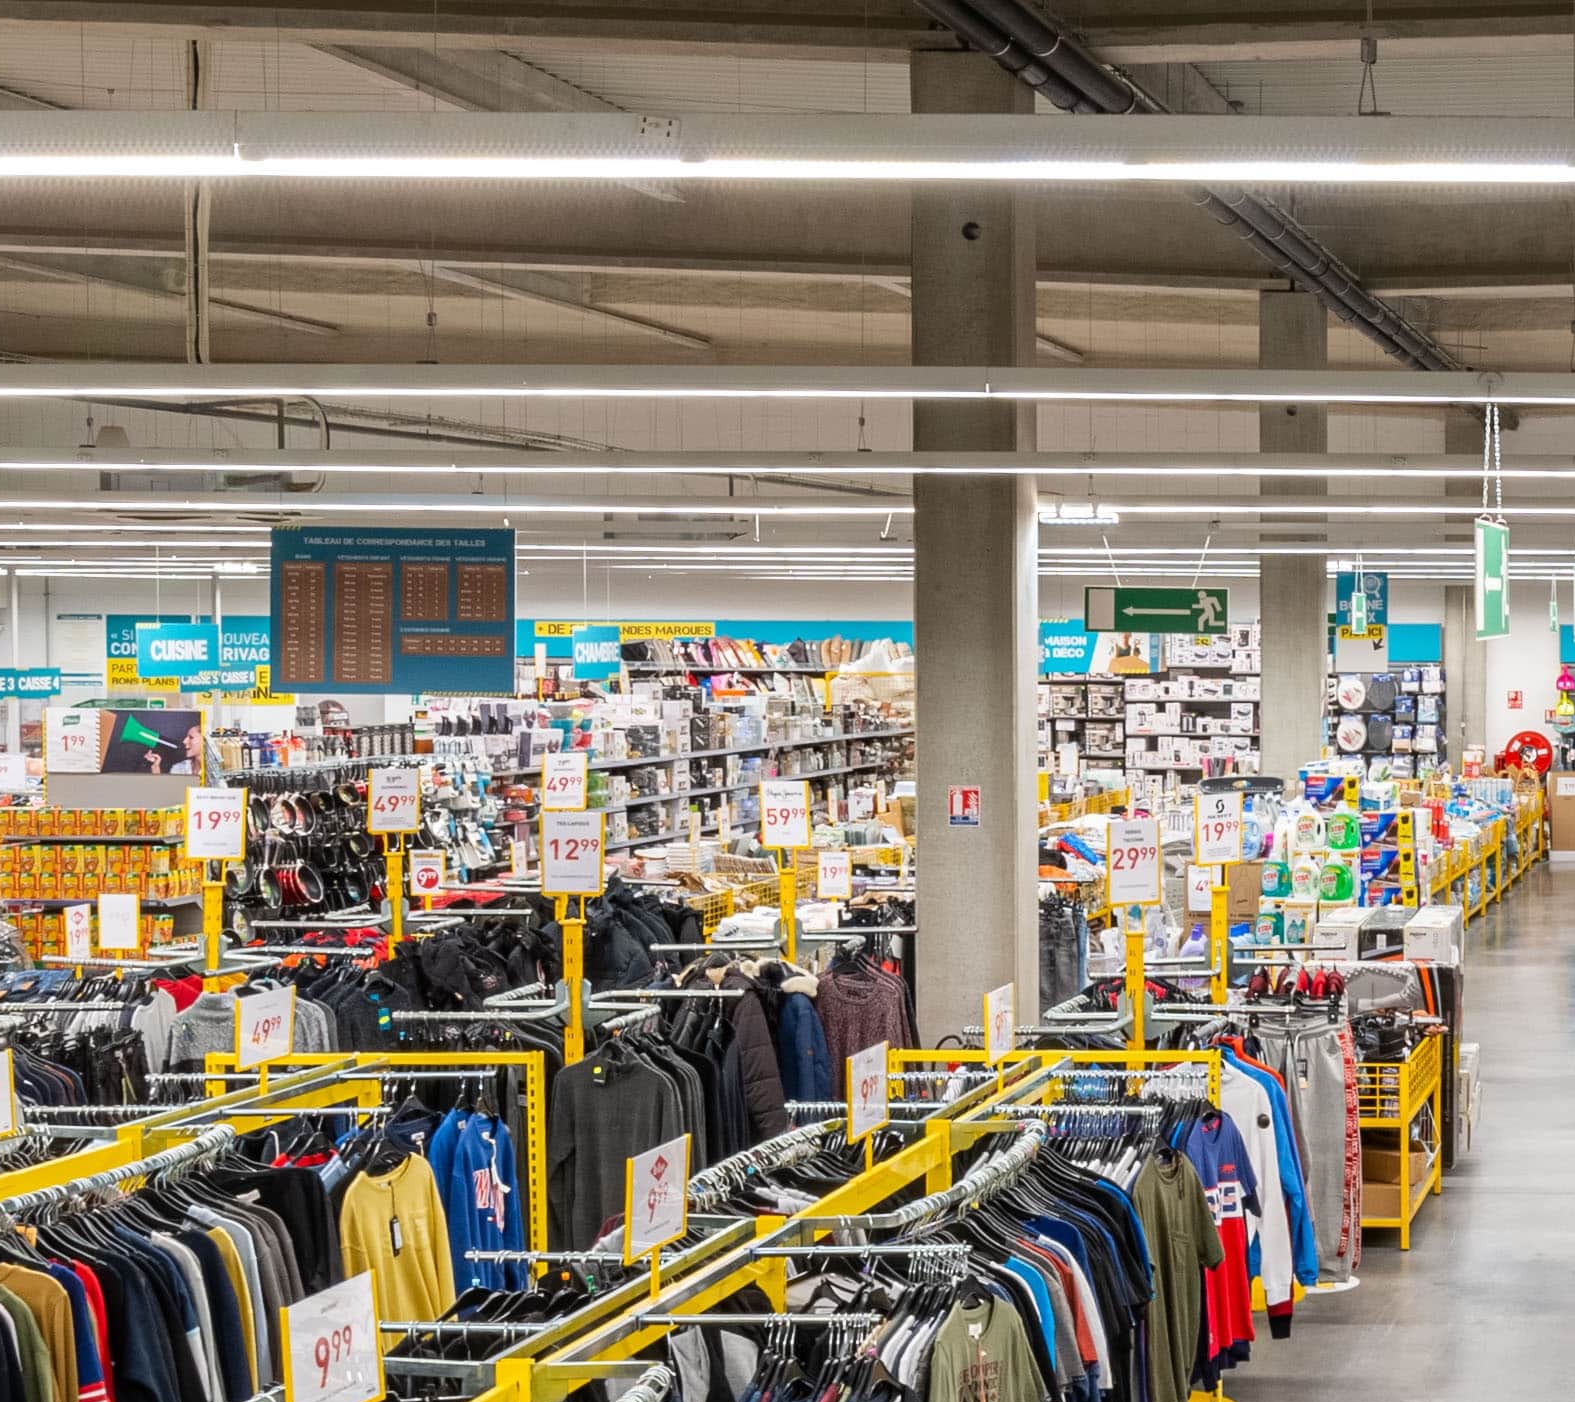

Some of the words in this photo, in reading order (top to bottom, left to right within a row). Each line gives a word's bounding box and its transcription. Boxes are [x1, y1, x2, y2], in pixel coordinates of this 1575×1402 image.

[620, 625, 652, 636] ANDES
[1044, 636, 1087, 648] MAISON
[150, 640, 209, 661] CUISINE
[576, 643, 621, 663] CHAMBRE
[8, 677, 15, 691] 3
[19, 677, 52, 691] CAISSE
